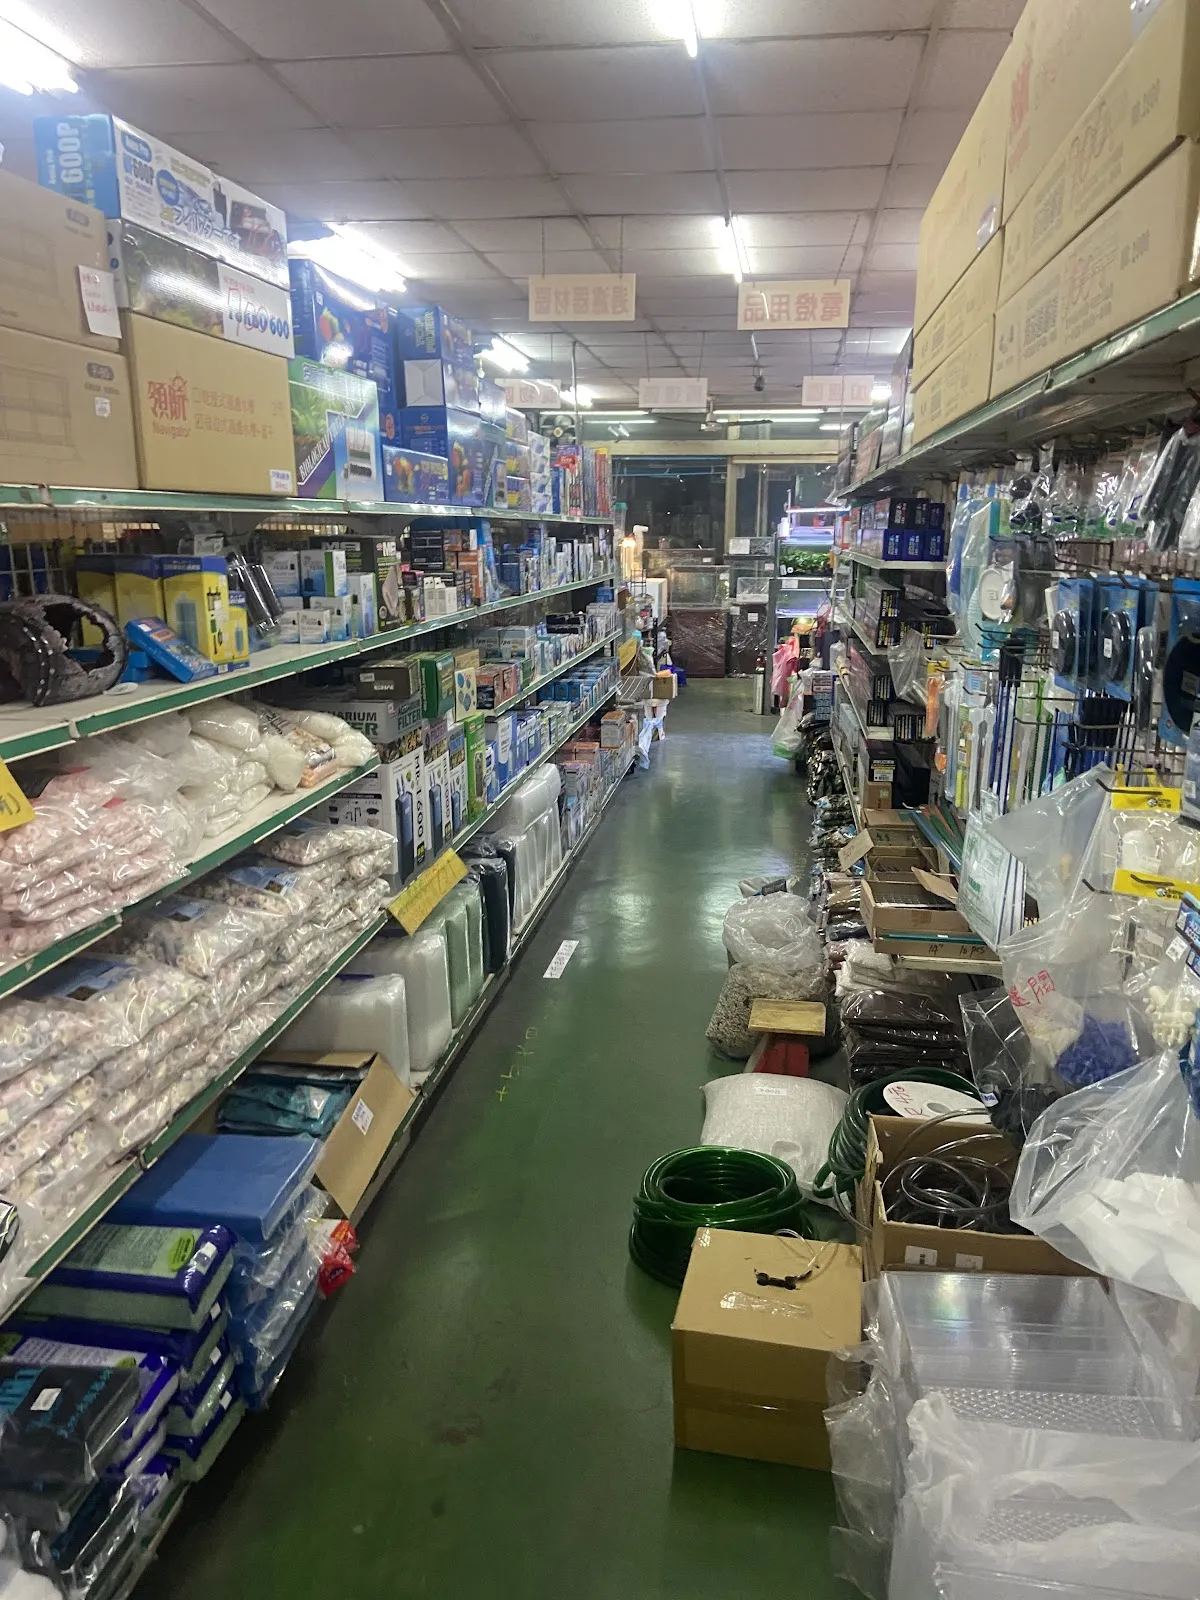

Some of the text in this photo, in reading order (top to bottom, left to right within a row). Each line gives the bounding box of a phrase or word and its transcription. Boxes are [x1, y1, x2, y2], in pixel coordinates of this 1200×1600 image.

[270, 318, 290, 340] 600
[397, 708, 421, 731] FILTER
[969, 945, 985, 958] pcs
